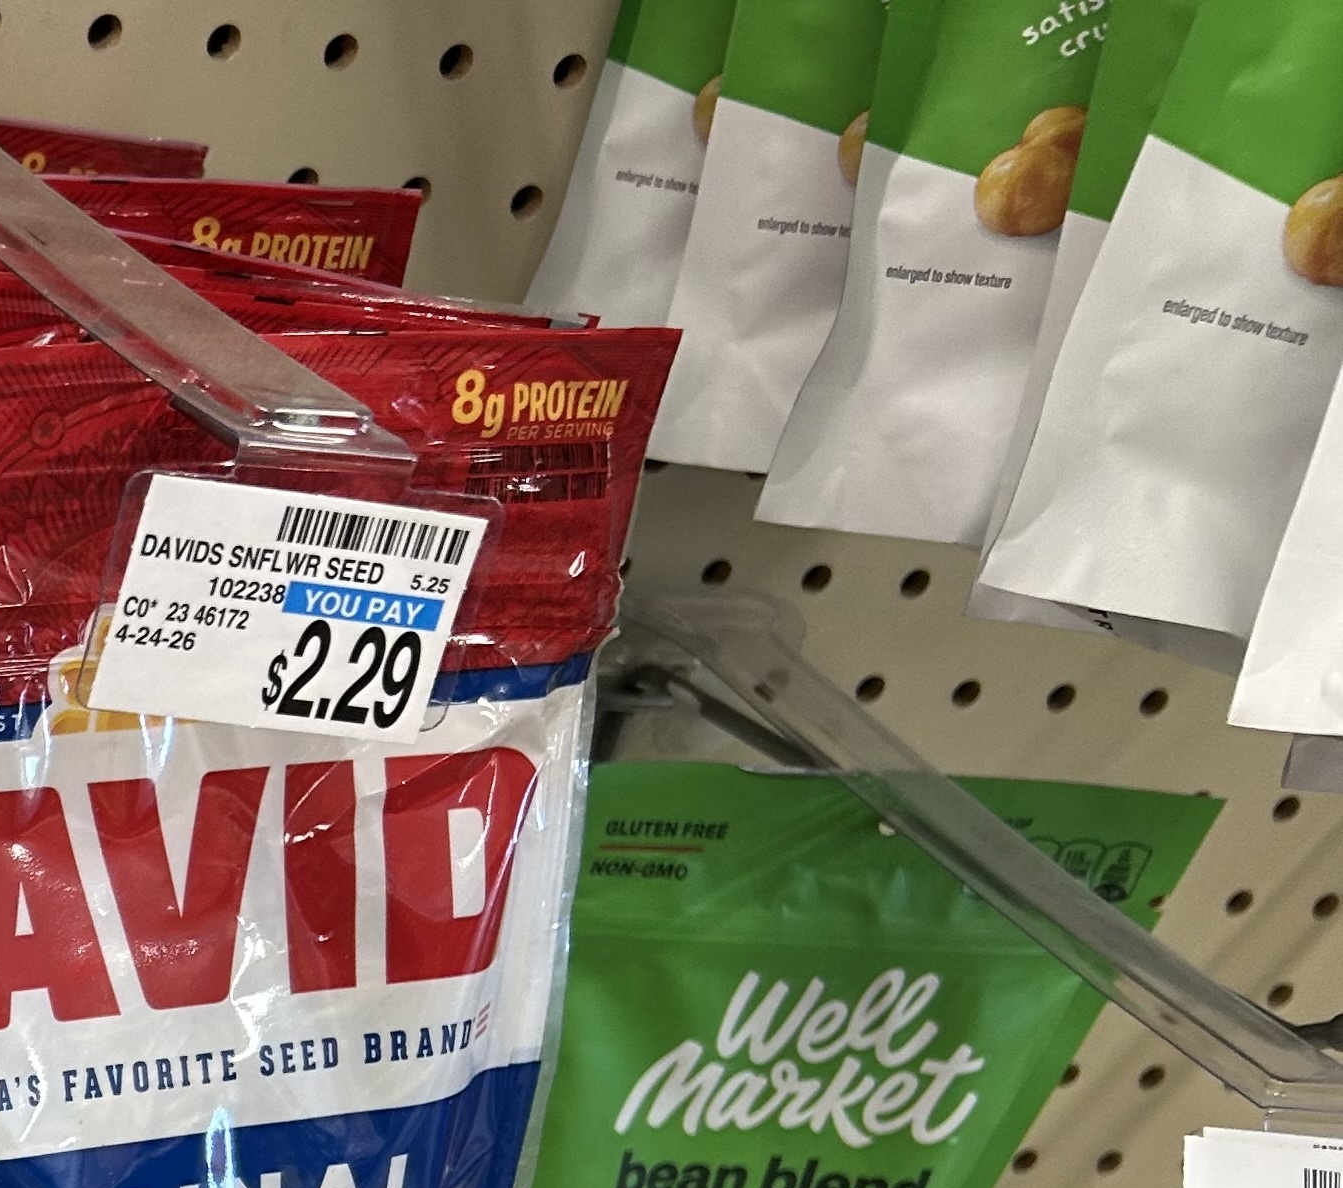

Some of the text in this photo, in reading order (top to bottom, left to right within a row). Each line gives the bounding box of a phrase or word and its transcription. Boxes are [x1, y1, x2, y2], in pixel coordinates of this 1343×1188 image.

[887, 265, 1012, 289] enlarged texture
[1163, 299, 1309, 346] enlarged texture
[452, 368, 630, 439] 8g PROTEIN
[543, 421, 615, 440] SERVING
[139, 533, 450, 595] DAVIDS SNFLWR SEED 5.25
[192, 605, 251, 631] 46172
[208, 577, 424, 627] 102238 YOU PAY
[114, 624, 198, 651] 4-24-26
[261, 618, 422, 729] $2.29
[605, 819, 679, 838] GLUTEN
[589, 859, 688, 881] NON-GMO
[716, 967, 941, 1069] Well
[63, 1050, 239, 1103] FAVORITE
[259, 1026, 341, 1079] SEED
[363, 1018, 472, 1066] BRAND
[614, 1038, 985, 1149] Market
